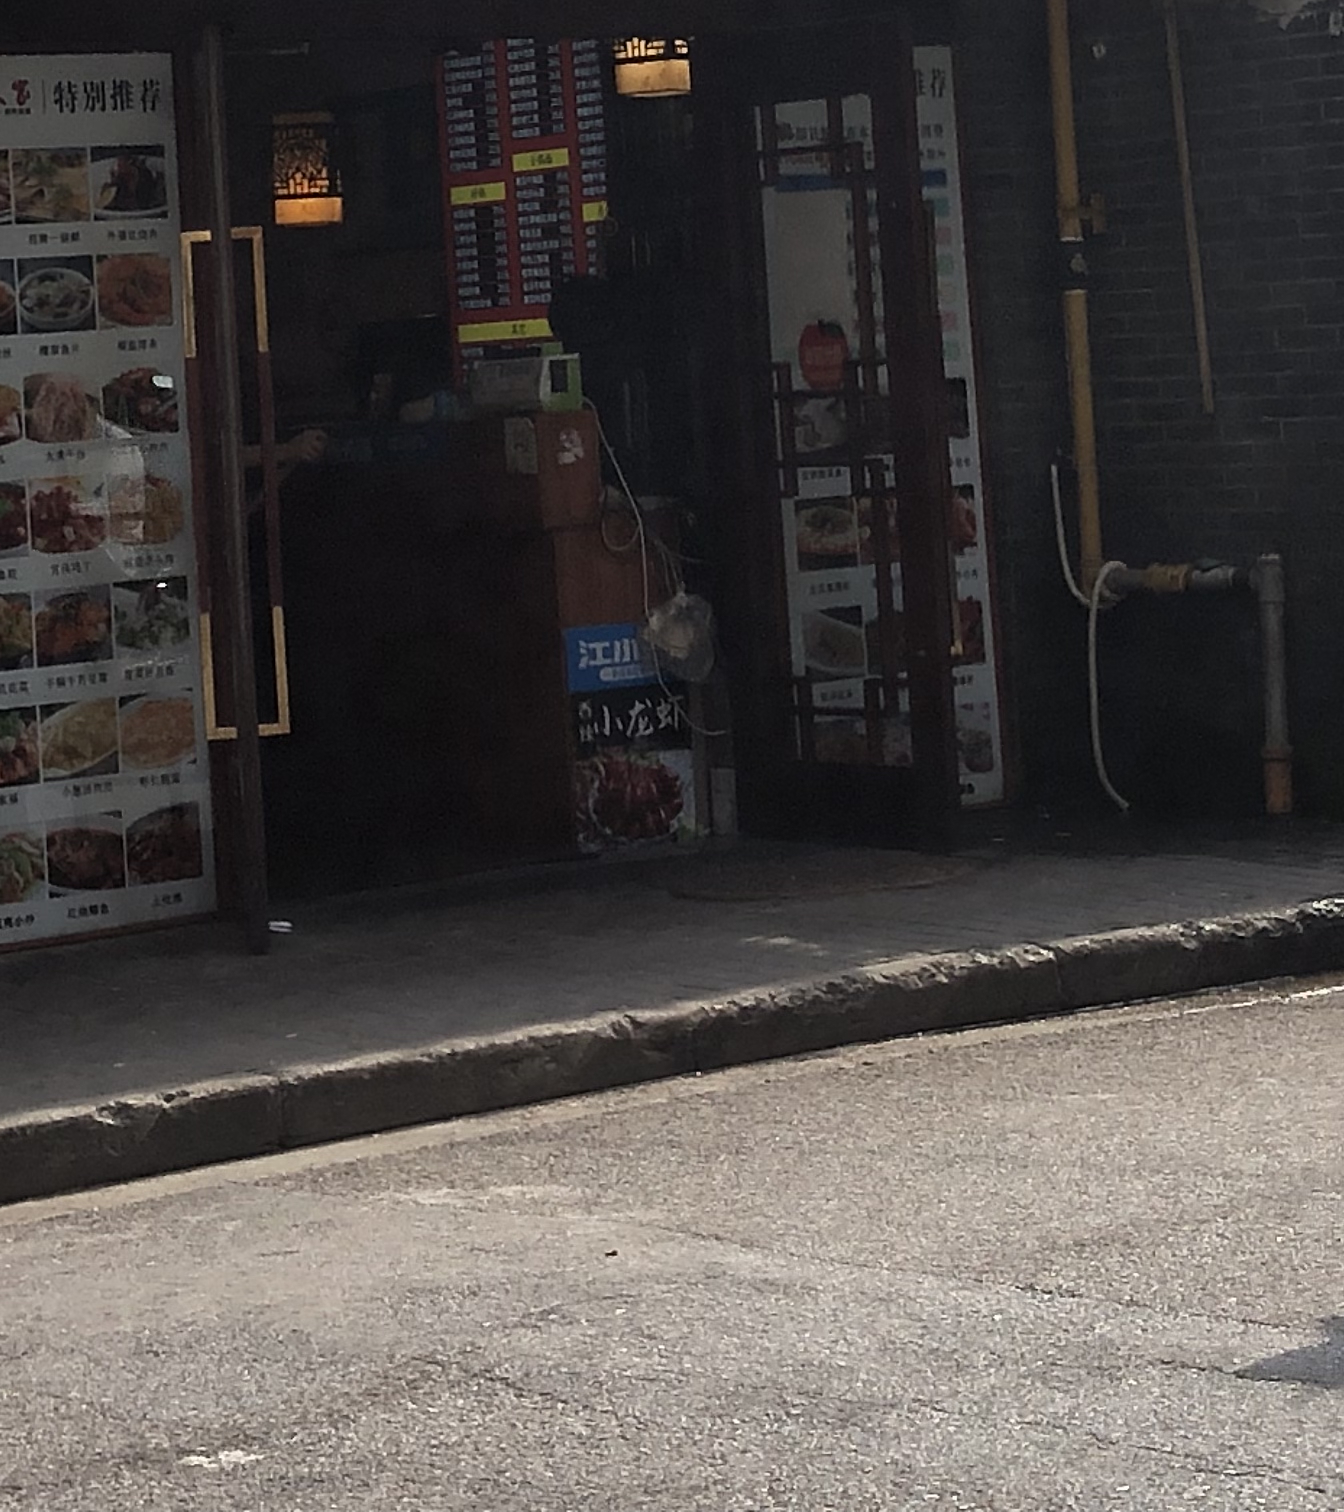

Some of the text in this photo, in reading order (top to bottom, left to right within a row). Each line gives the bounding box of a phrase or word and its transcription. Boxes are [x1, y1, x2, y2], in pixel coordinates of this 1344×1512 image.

[52, 78, 163, 115] 特别推荐
[578, 638, 642, 670] 江小
[594, 695, 684, 738] 小龙虾
